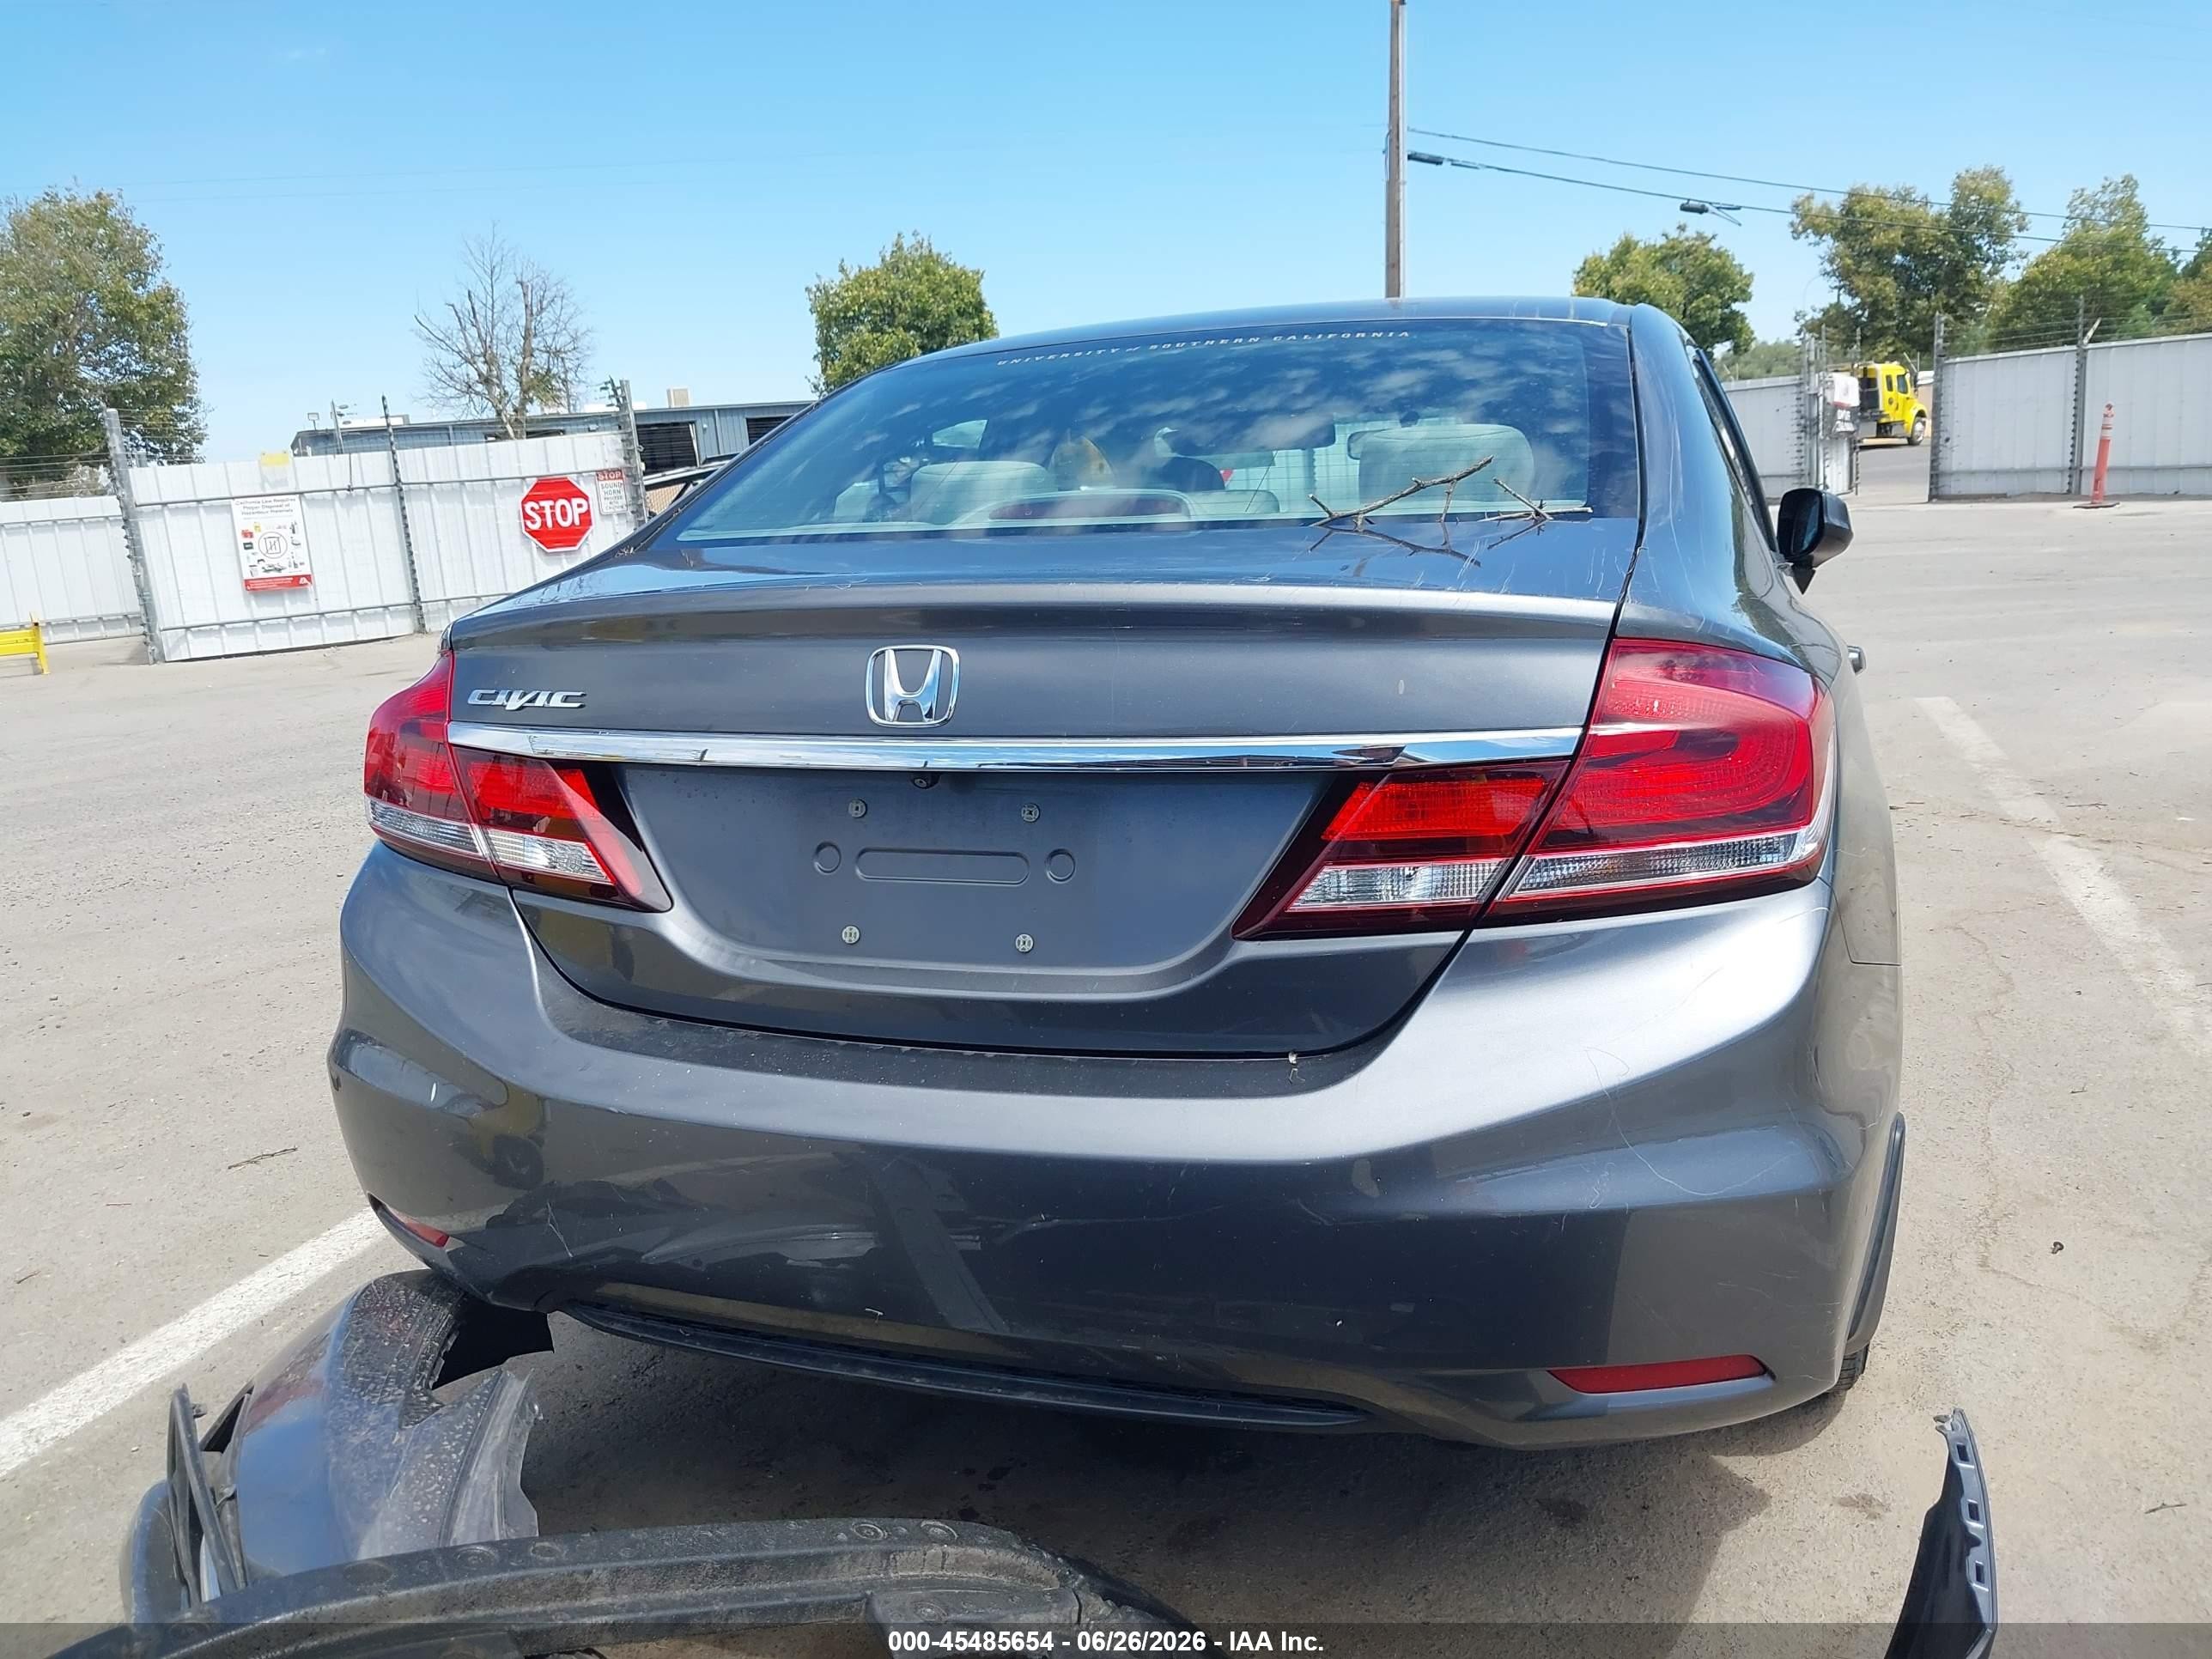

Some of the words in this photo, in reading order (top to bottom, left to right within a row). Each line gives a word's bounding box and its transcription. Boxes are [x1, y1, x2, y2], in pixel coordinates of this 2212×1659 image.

[996, 347, 1121, 366] UNIVERSITY
[1148, 337, 1261, 350] SOUTHERN
[1273, 331, 1409, 341] CALIFORNIA
[598, 470, 622, 480] STOP
[524, 497, 589, 530] STOP
[467, 689, 586, 711] CIVIC
